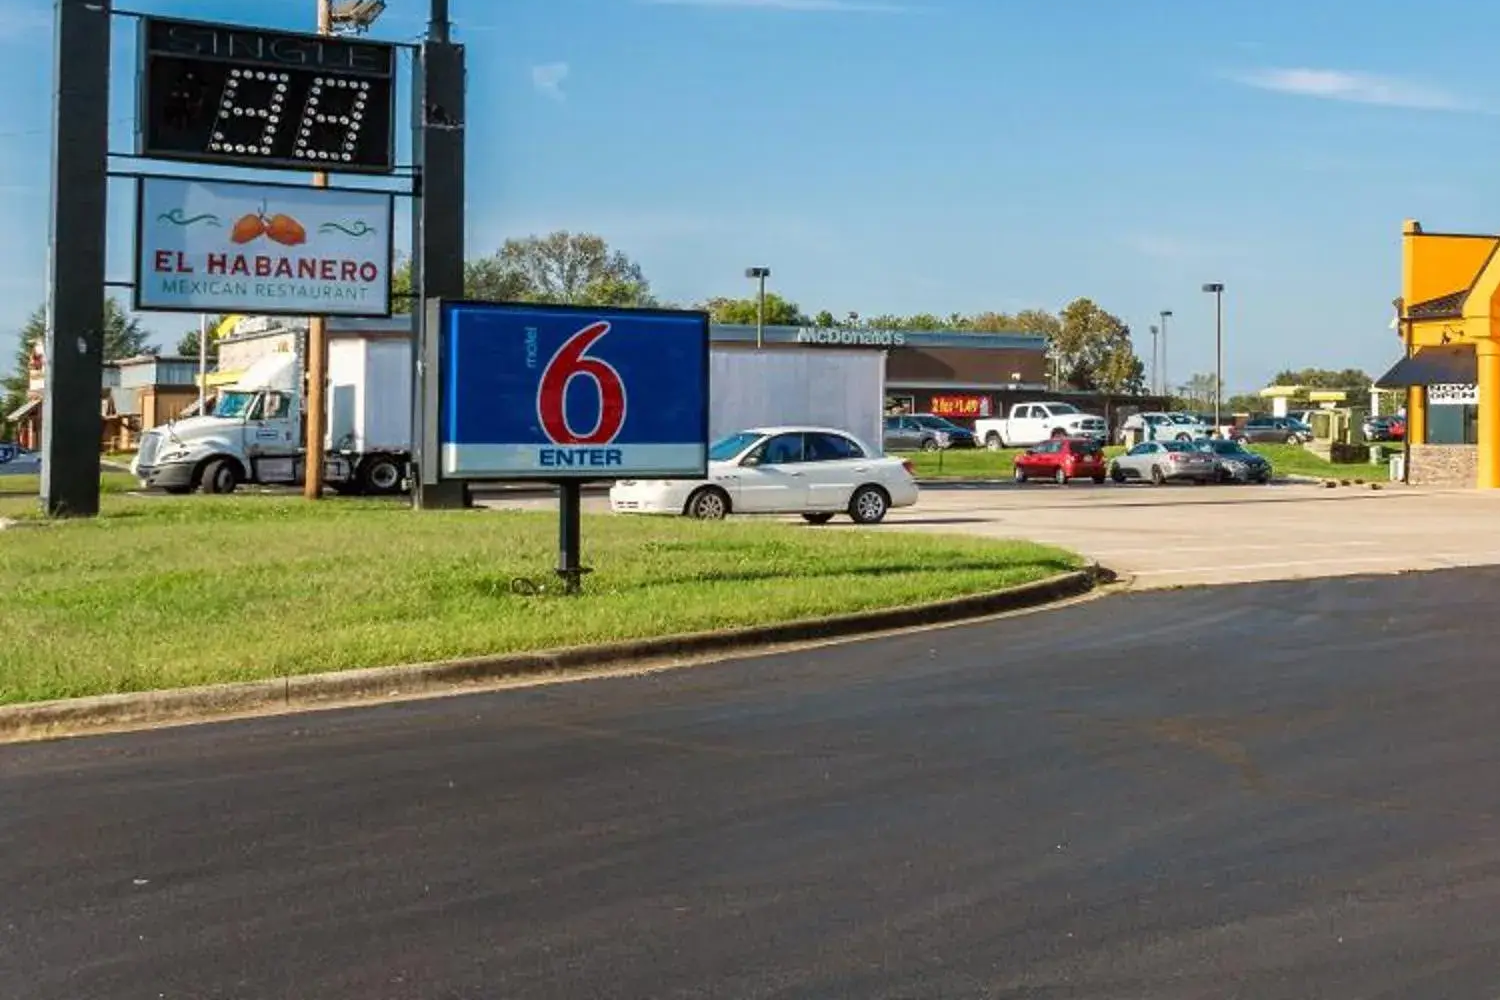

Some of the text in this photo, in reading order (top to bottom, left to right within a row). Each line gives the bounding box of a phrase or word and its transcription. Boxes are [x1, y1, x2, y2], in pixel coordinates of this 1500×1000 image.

[170, 25, 378, 71] SINGLE
[155, 250, 379, 283] EL HABANERO
[162, 279, 368, 301] MEXICAN RESTAURANT
[797, 326, 905, 345] McDonald's
[524, 326, 538, 369] motel
[536, 320, 627, 446] 6
[1429, 382, 1475, 391] NOW
[1430, 391, 1475, 399] OPEN
[539, 449, 622, 467] ENTER
